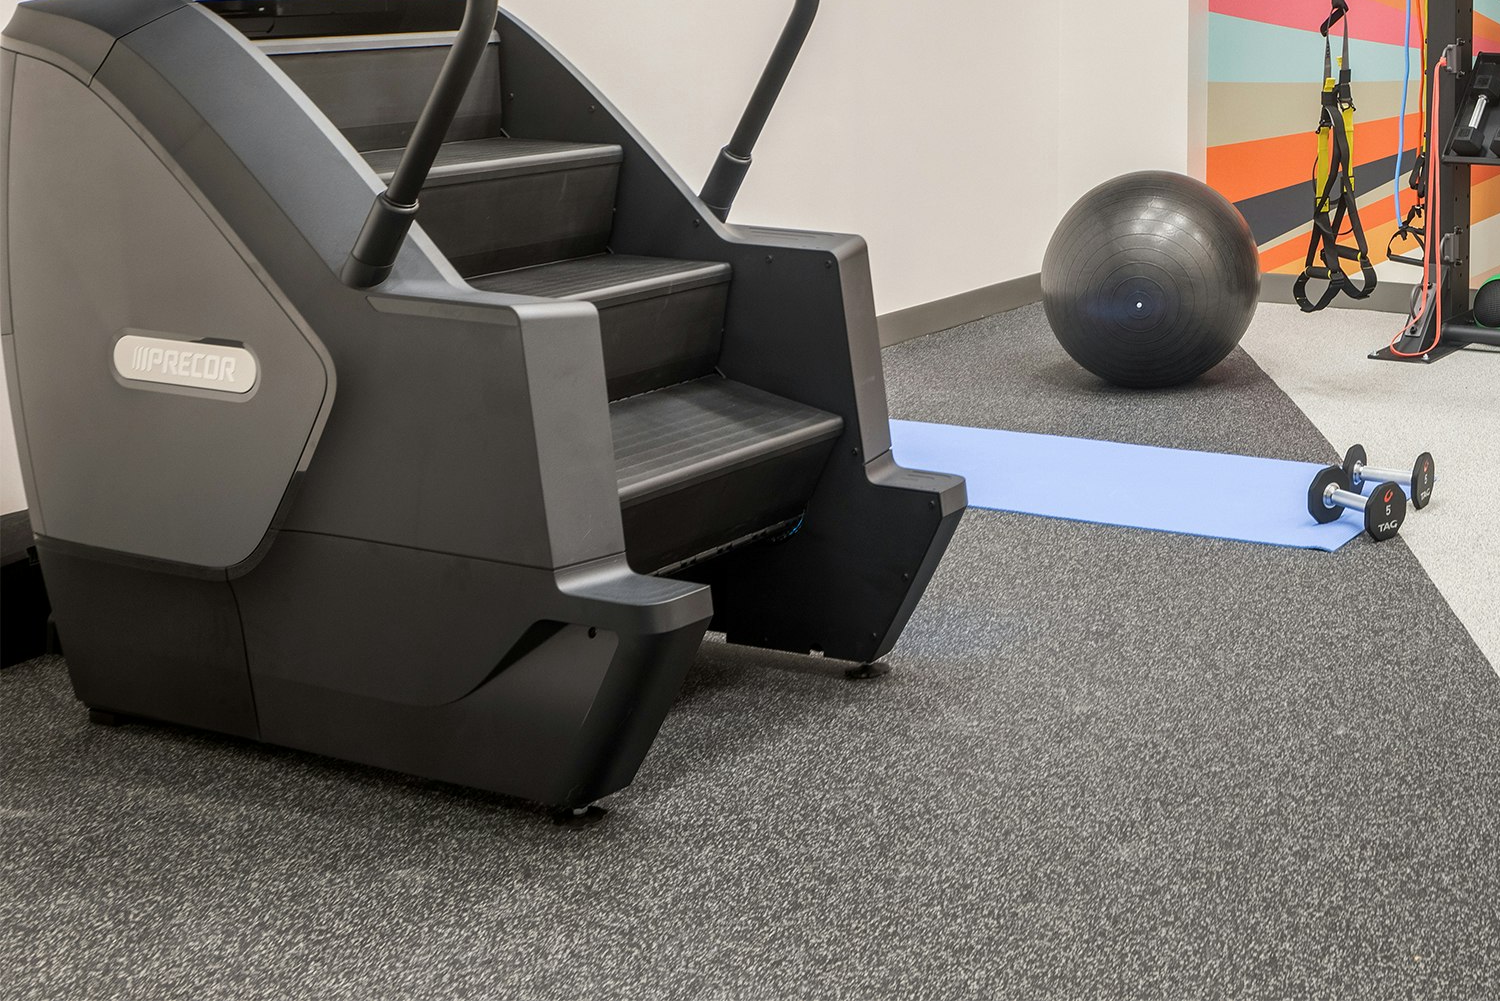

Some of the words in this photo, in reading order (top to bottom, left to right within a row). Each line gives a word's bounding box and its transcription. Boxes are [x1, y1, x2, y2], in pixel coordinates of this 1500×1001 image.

[144, 347, 236, 382] PRECOR
[1385, 504, 1392, 516] 5
[1377, 519, 1398, 533] TAG
